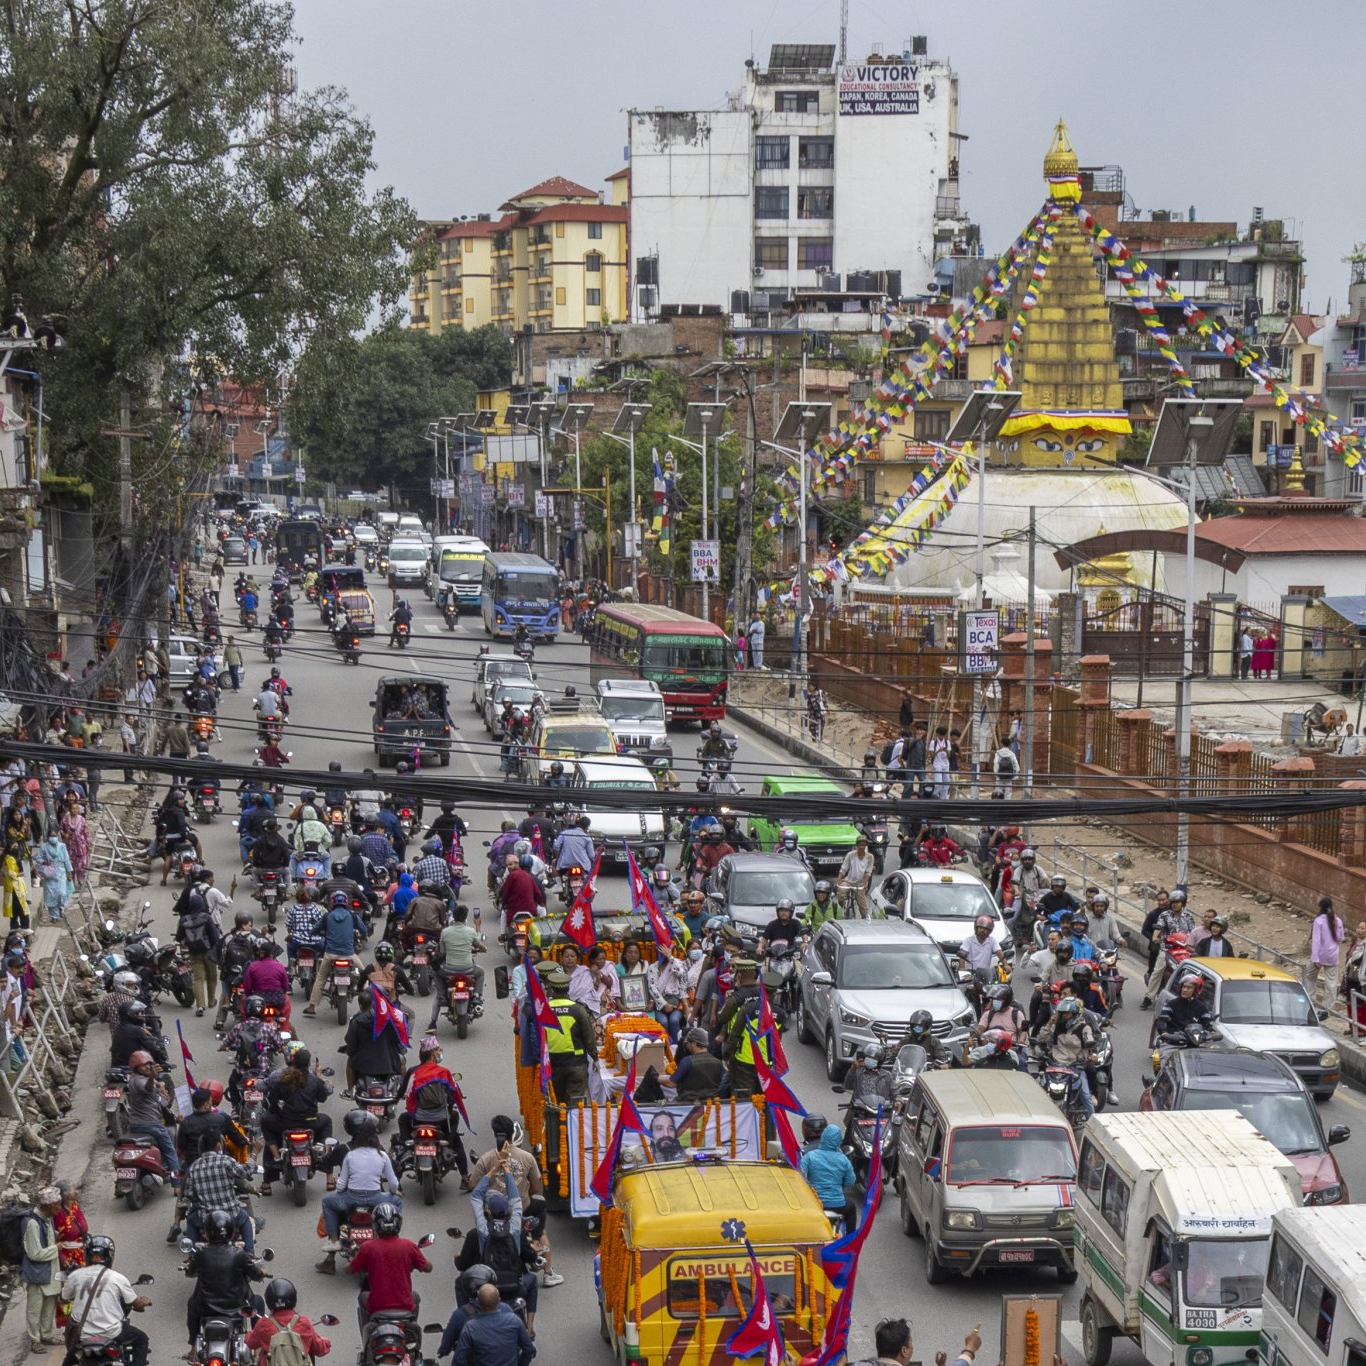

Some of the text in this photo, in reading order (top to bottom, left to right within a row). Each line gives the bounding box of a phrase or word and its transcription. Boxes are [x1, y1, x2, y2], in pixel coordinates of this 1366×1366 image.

[856, 66, 919, 82] VICTORY
[840, 82, 918, 91] EDUCATIONAL CONSULTANCY
[840, 91, 918, 103] JAPAN, KOREA, CANADA
[840, 102, 918, 115] UK, USA, AUSTRALIA
[509, 492, 524, 500] BIT
[693, 549, 713, 557] BBA
[696, 558, 718, 567] BHM
[975, 616, 997, 628] Texas
[969, 631, 994, 644] BCA
[592, 781, 625, 789] TOURIST
[1186, 1318, 1216, 1329] 4030
